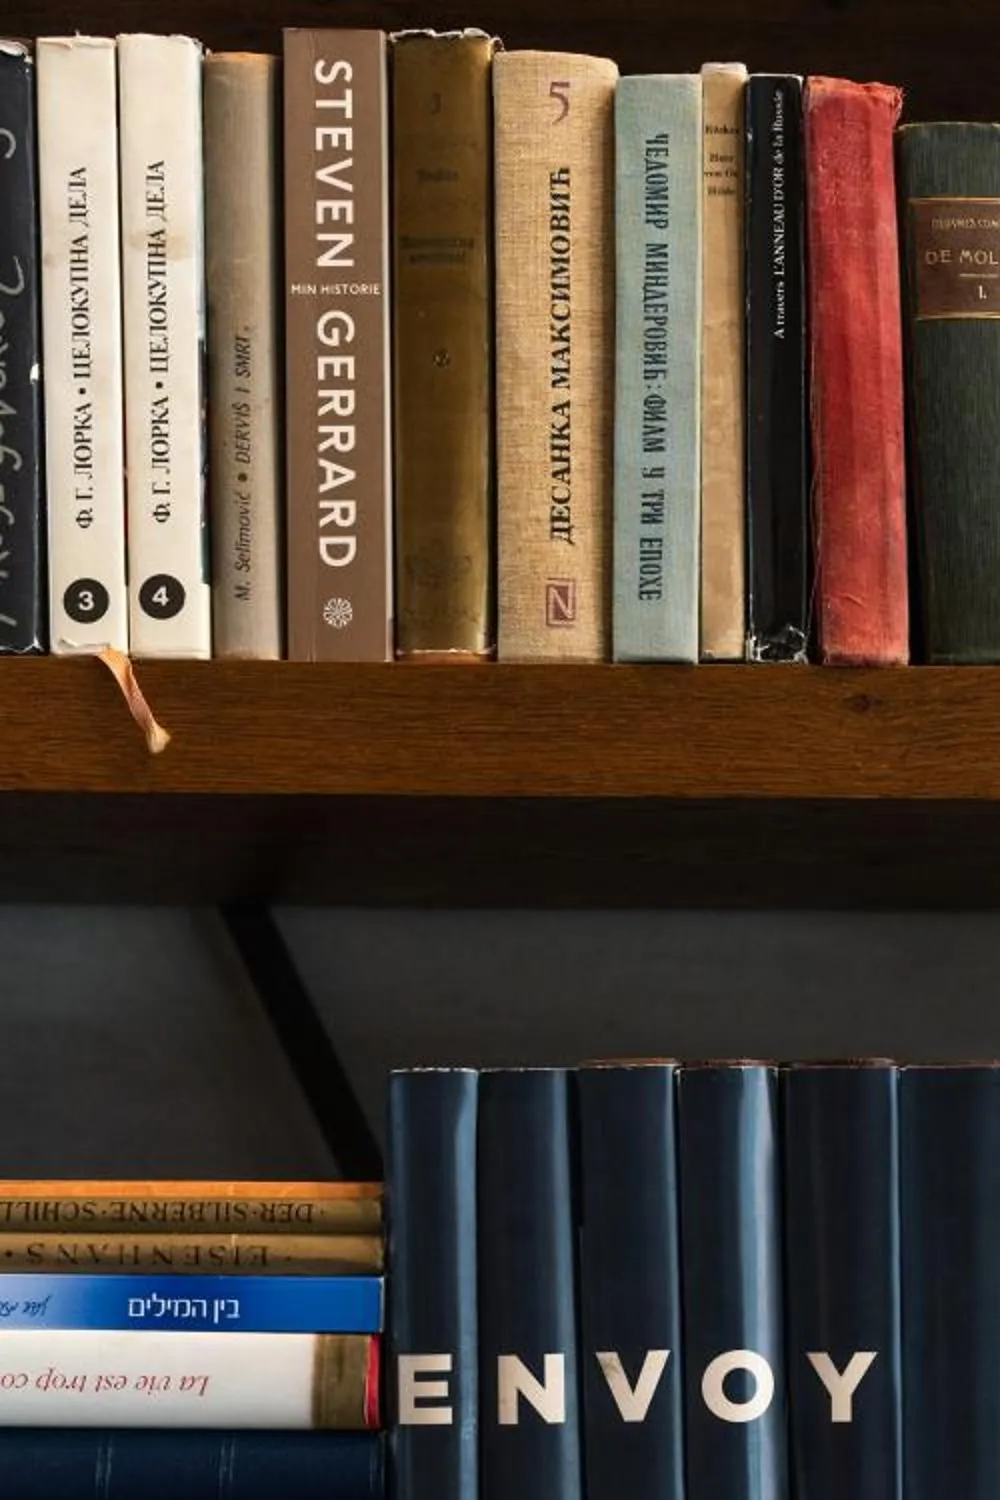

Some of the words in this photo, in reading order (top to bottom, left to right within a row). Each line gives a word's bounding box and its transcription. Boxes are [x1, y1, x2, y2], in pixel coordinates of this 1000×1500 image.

[548, 81, 571, 126] 5
[314, 59, 355, 268] STEVEN
[646, 132, 670, 229] ЧЕДОМИР
[68, 166, 90, 229] ДЕЛА
[147, 160, 167, 224] ДЕЛА
[548, 166, 573, 390] МАКСИМОВИЋ
[925, 250, 952, 266] DE
[71, 235, 92, 380] ЦЕЛОКУПНА
[149, 228, 170, 374] ЦЕЛОКУПНА
[290, 283, 316, 296] MIN
[319, 283, 381, 296] HISTORIE
[73, 402, 94, 481] ЛОРКА
[150, 395, 171, 476] ЛОРКА
[232, 402, 251, 465] DERVIŠ
[316, 308, 357, 569] GERRARD
[76, 486, 92, 500] Г.
[152, 480, 168, 496] Г.
[548, 398, 575, 545] ДЕСАНКА
[76, 502, 94, 530] Ф.
[152, 501, 171, 524] Ф.
[640, 489, 664, 524] ТРИ
[233, 489, 251, 573] Selimović
[638, 536, 663, 601] ЕПОХЕ
[107, 1202, 249, 1223] SILBERNE
[260, 1202, 314, 1223] DER
[128, 1292, 208, 1318] המילים
[212, 1298, 241, 1324] בין
[35, 1367, 88, 1394] trop
[94, 1374, 128, 1394] est
[135, 1374, 171, 1395] vie
[179, 1374, 210, 1397] La
[396, 1350, 881, 1427] ENVOY
